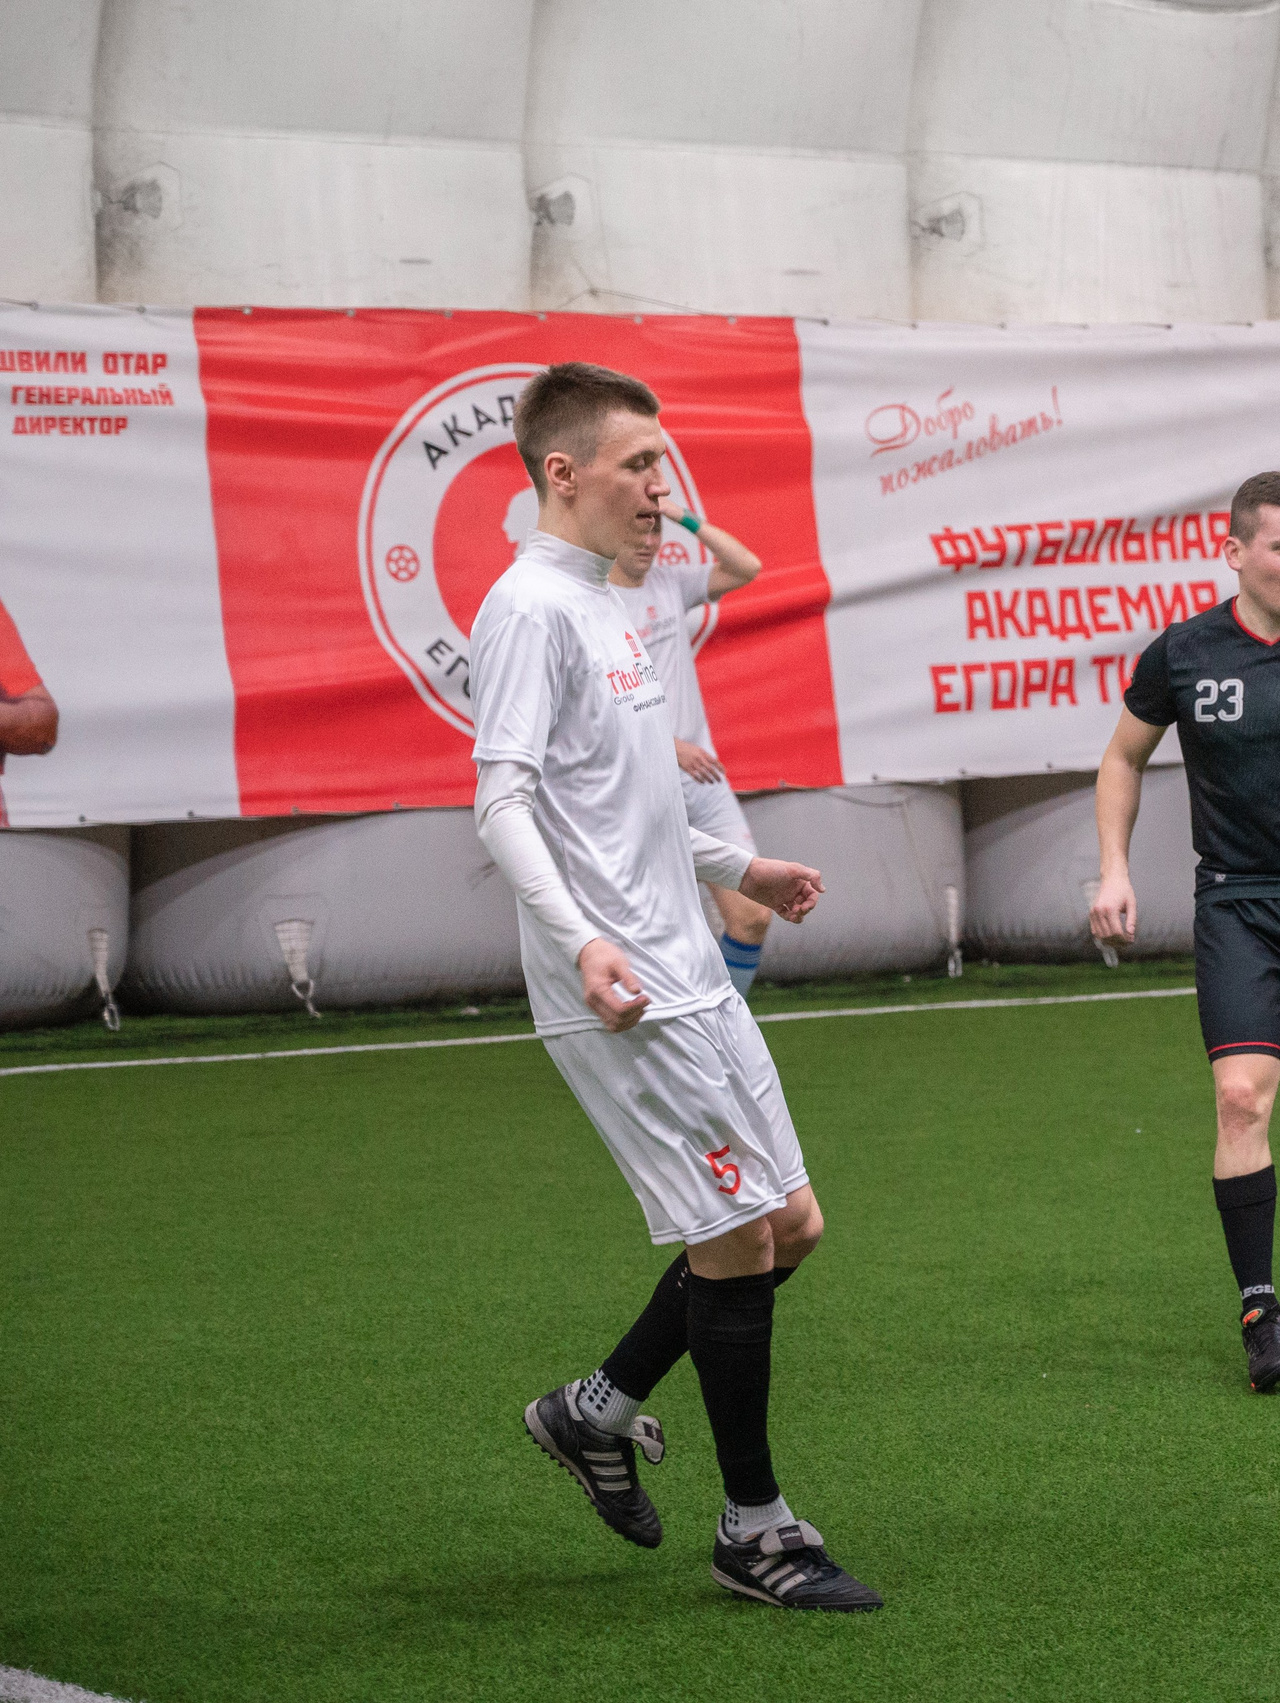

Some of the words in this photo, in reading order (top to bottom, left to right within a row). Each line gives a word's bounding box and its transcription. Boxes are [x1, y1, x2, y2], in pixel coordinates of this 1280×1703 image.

[102, 352, 168, 376] ОТАР
[11, 383, 175, 407] ГЕНЕРАЛЬНЫЙ
[12, 415, 129, 436] ДИРЕКТОР
[865, 386, 975, 458] Добро
[879, 385, 1063, 495] пожаловать!
[929, 511, 1231, 572] ФУТБОЛЬНАЯ
[965, 580, 1217, 642] АКАДЕМИЯ
[930, 658, 1077, 713] ЕГОРА
[1195, 678, 1244, 722] 23
[705, 1145, 741, 1196] 5
